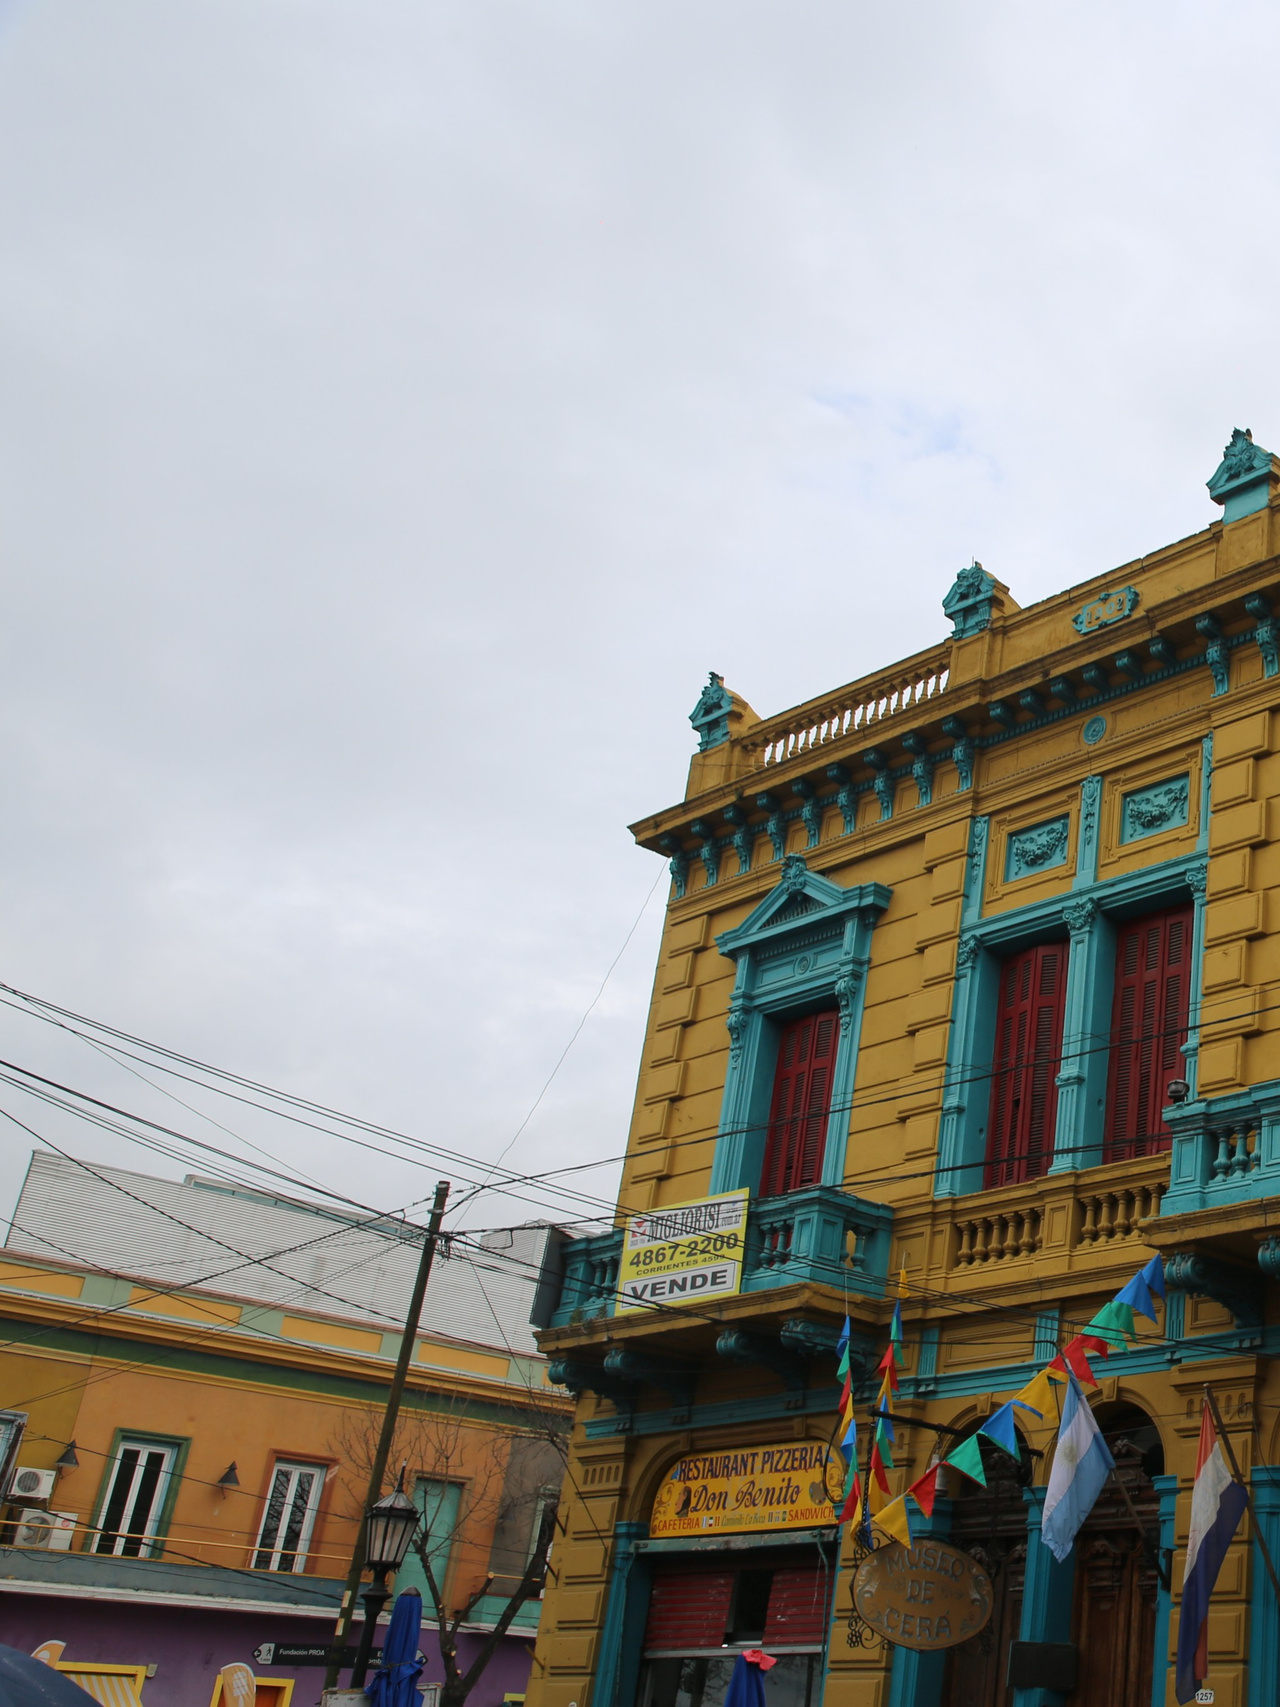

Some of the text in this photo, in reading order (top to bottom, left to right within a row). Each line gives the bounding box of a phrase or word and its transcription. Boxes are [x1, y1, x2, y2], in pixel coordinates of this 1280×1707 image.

[1086, 597, 1124, 624] 1902
[647, 1203, 722, 1242] MIGLIORISI
[629, 1232, 739, 1268] 4867-2200
[636, 1259, 699, 1276] CORRIENTES
[630, 1269, 728, 1301] VENDE
[677, 1446, 825, 1484] RESTAURANT PIZZERIA
[690, 1476, 802, 1513] Don Benito
[657, 1516, 700, 1532] CAFETERIA
[788, 1506, 834, 1522] SANDWICH
[885, 1547, 965, 1582] MUSEO
[906, 1579, 936, 1605] DE
[279, 1648, 308, 1656] Fundación
[1196, 1692, 1213, 1701] 1257
